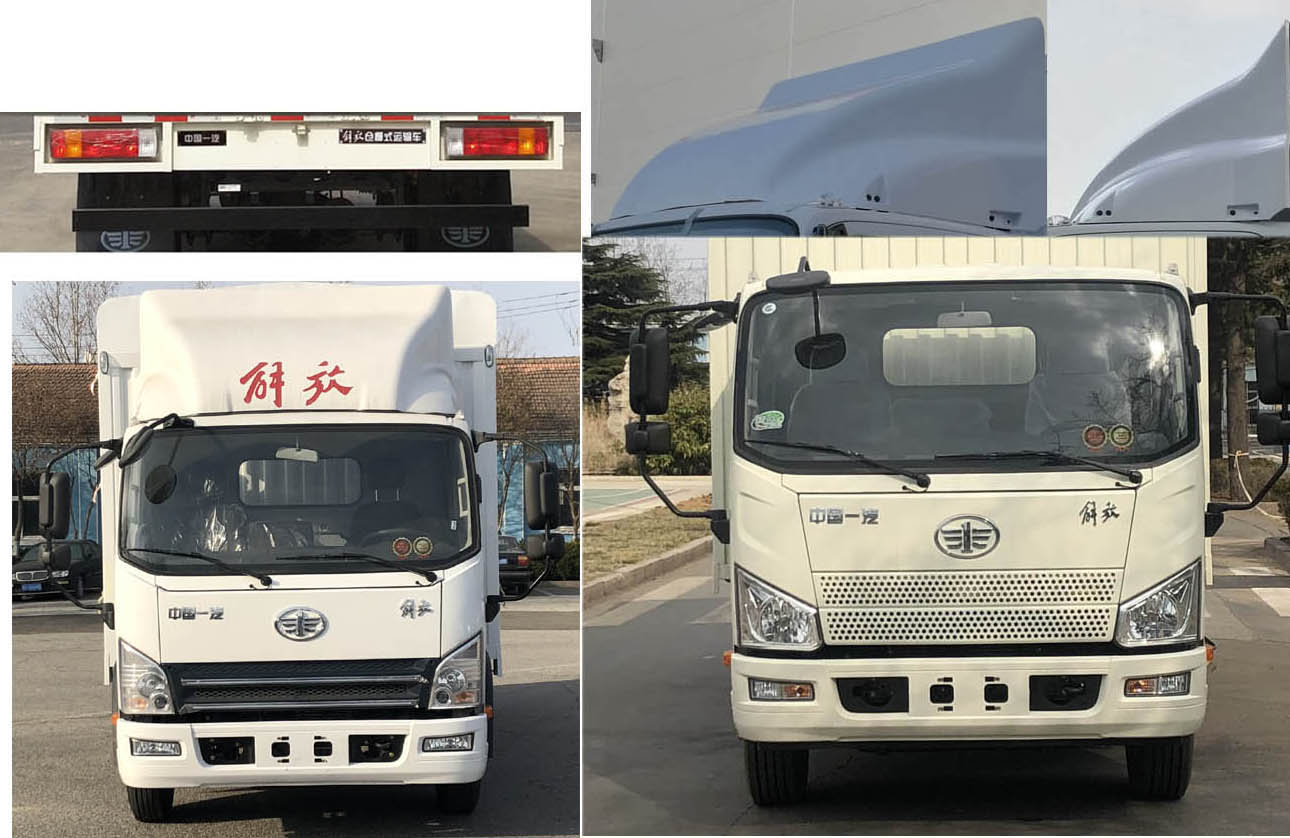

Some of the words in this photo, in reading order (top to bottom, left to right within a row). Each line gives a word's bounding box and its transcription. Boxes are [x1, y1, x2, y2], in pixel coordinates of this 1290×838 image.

[184, 133, 220, 144] 中国一汽
[239, 361, 354, 408] 解放
[809, 508, 879, 525] 中国一汽
[1079, 501, 1121, 526] 解放
[168, 607, 224, 620] 中国一汽
[399, 599, 434, 619] 解放
